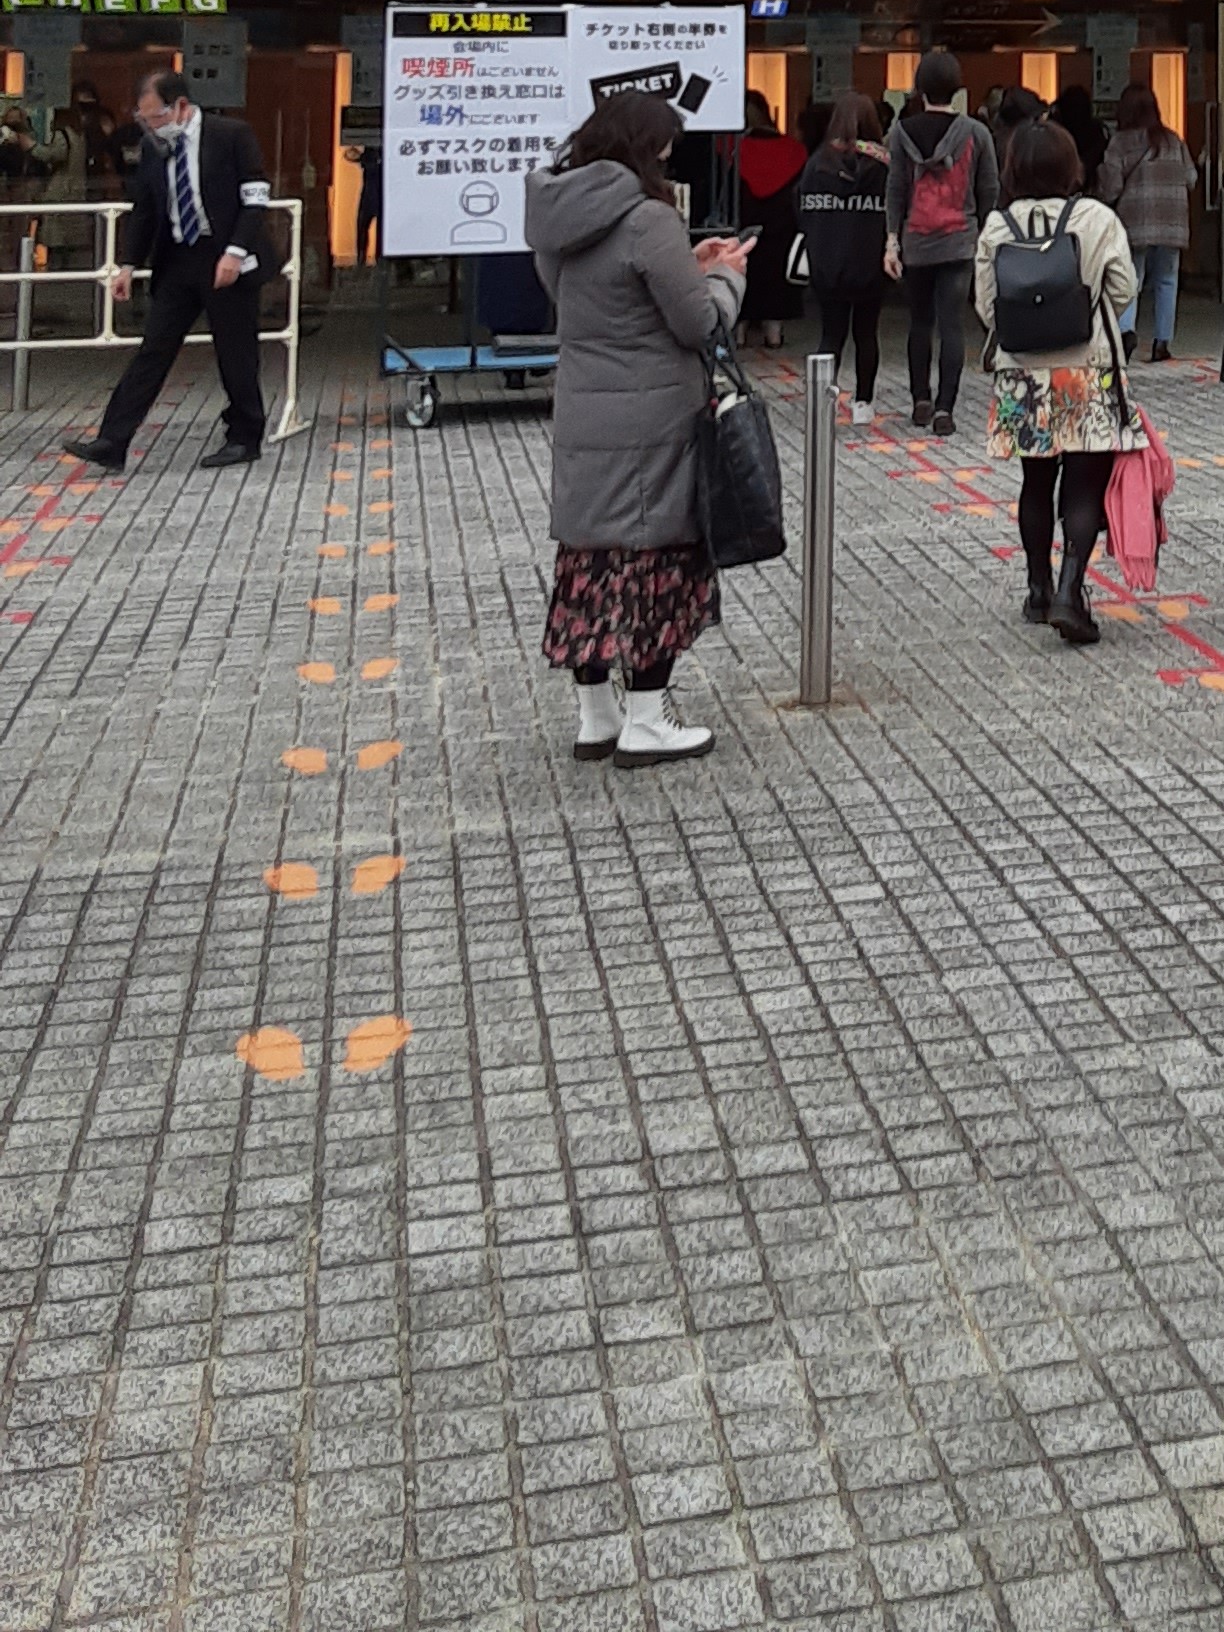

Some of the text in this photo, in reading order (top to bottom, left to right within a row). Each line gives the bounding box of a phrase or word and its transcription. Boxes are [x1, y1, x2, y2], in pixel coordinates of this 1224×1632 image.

[758, 0, 782, 14] H
[429, 13, 533, 32] 再入場禁止
